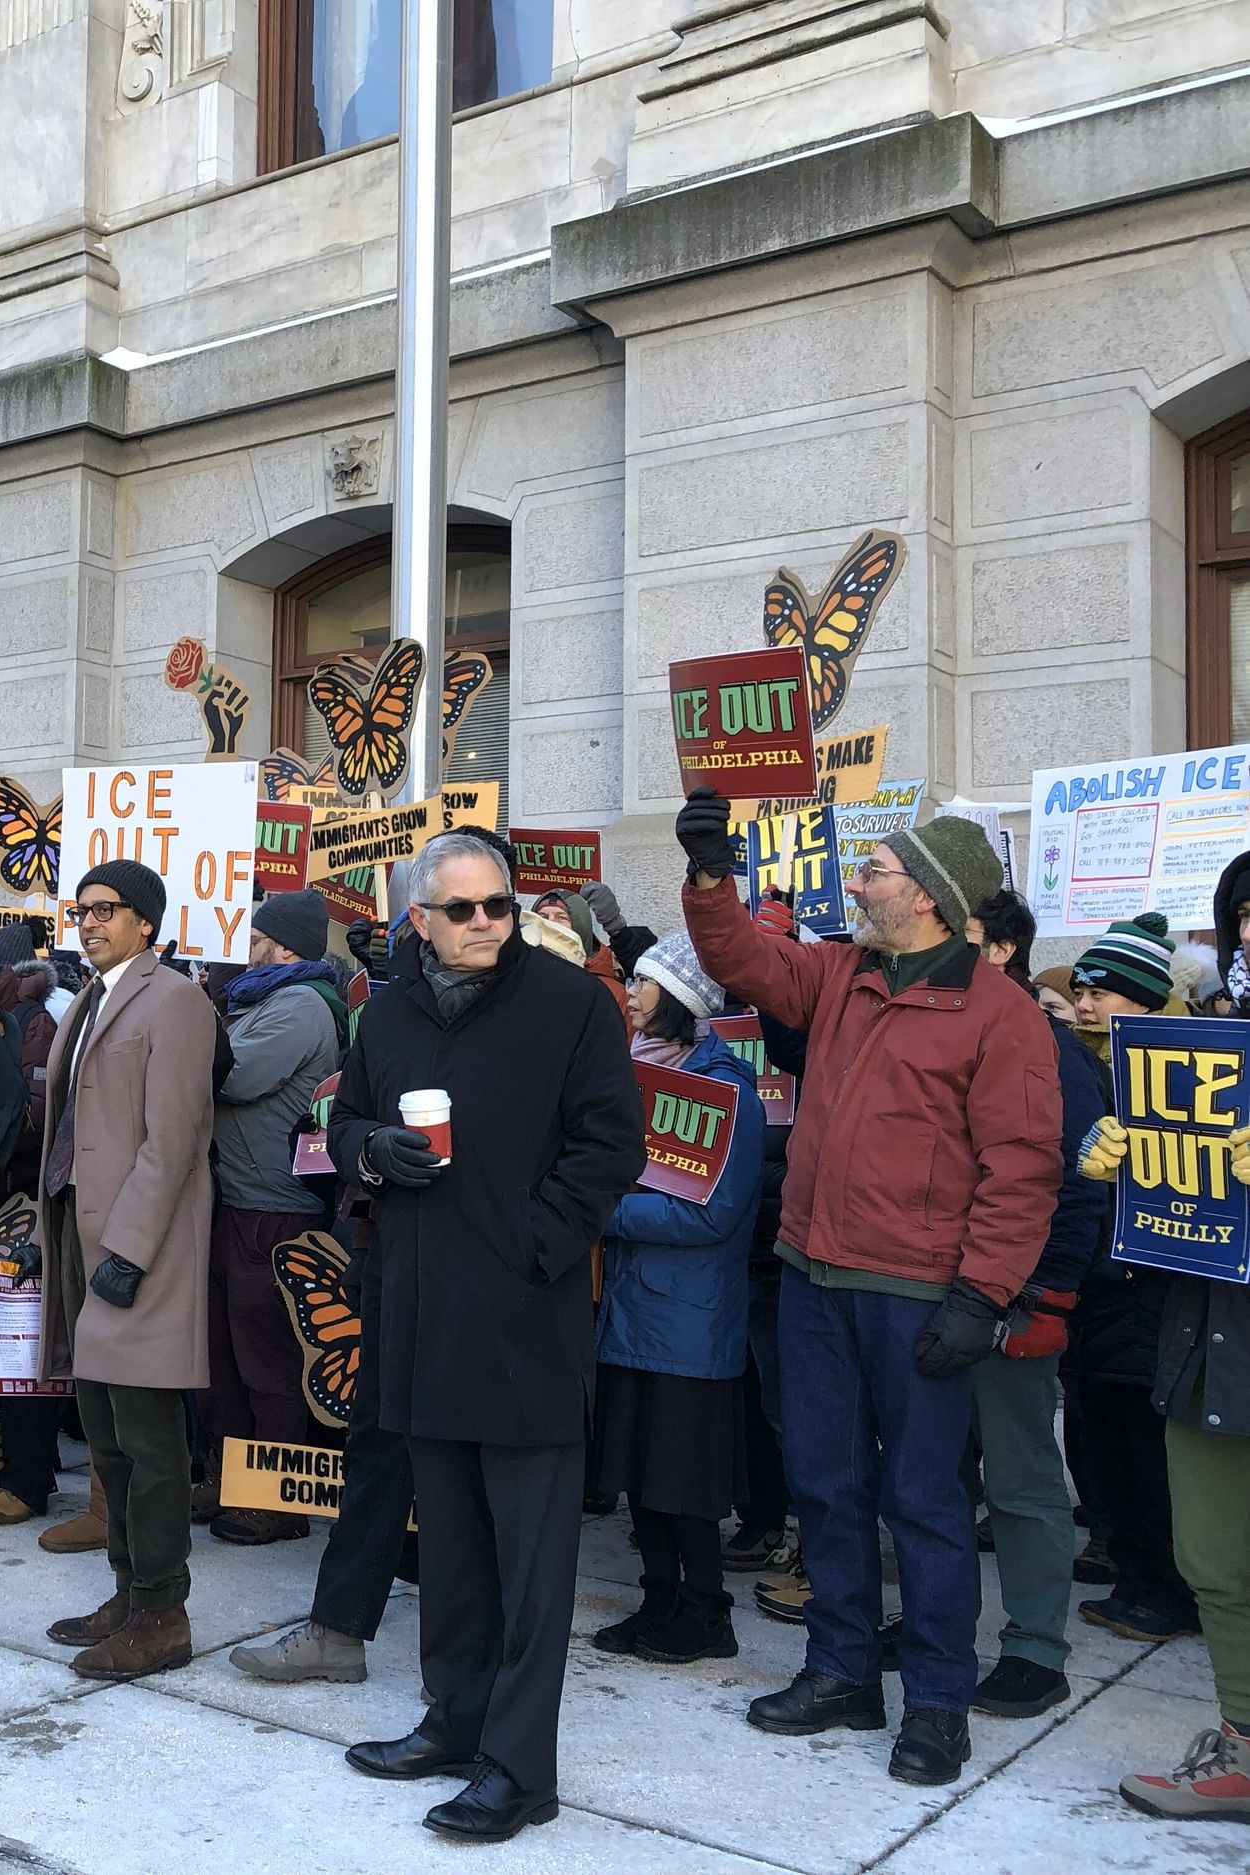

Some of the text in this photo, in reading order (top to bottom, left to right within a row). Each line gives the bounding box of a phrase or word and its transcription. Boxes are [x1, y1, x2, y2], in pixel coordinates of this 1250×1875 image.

[673, 680, 798, 740] ICE OUT
[682, 750, 803, 770] PHILADELPHIA
[713, 741, 727, 750] OF
[826, 735, 874, 771] MAKE
[87, 770, 173, 818] ICE
[1045, 755, 1246, 816] ABOLISH ICE
[392, 807, 427, 832] GROW
[836, 812, 912, 834] TO SURVIVE IS
[88, 827, 180, 875] OUT
[328, 833, 414, 869] COMMUNITIES
[513, 842, 596, 870] ICE OUT
[854, 840, 880, 856] TAK
[194, 850, 252, 901] OF
[56, 900, 246, 957] PLY
[1126, 1048, 1240, 1126] ICE
[651, 1092, 726, 1149] OUT
[646, 1147, 708, 1177] ELPHIA
[1126, 1128, 1234, 1200] OUT
[1170, 1201, 1198, 1216] OF
[1134, 1211, 1234, 1244] PHILLY
